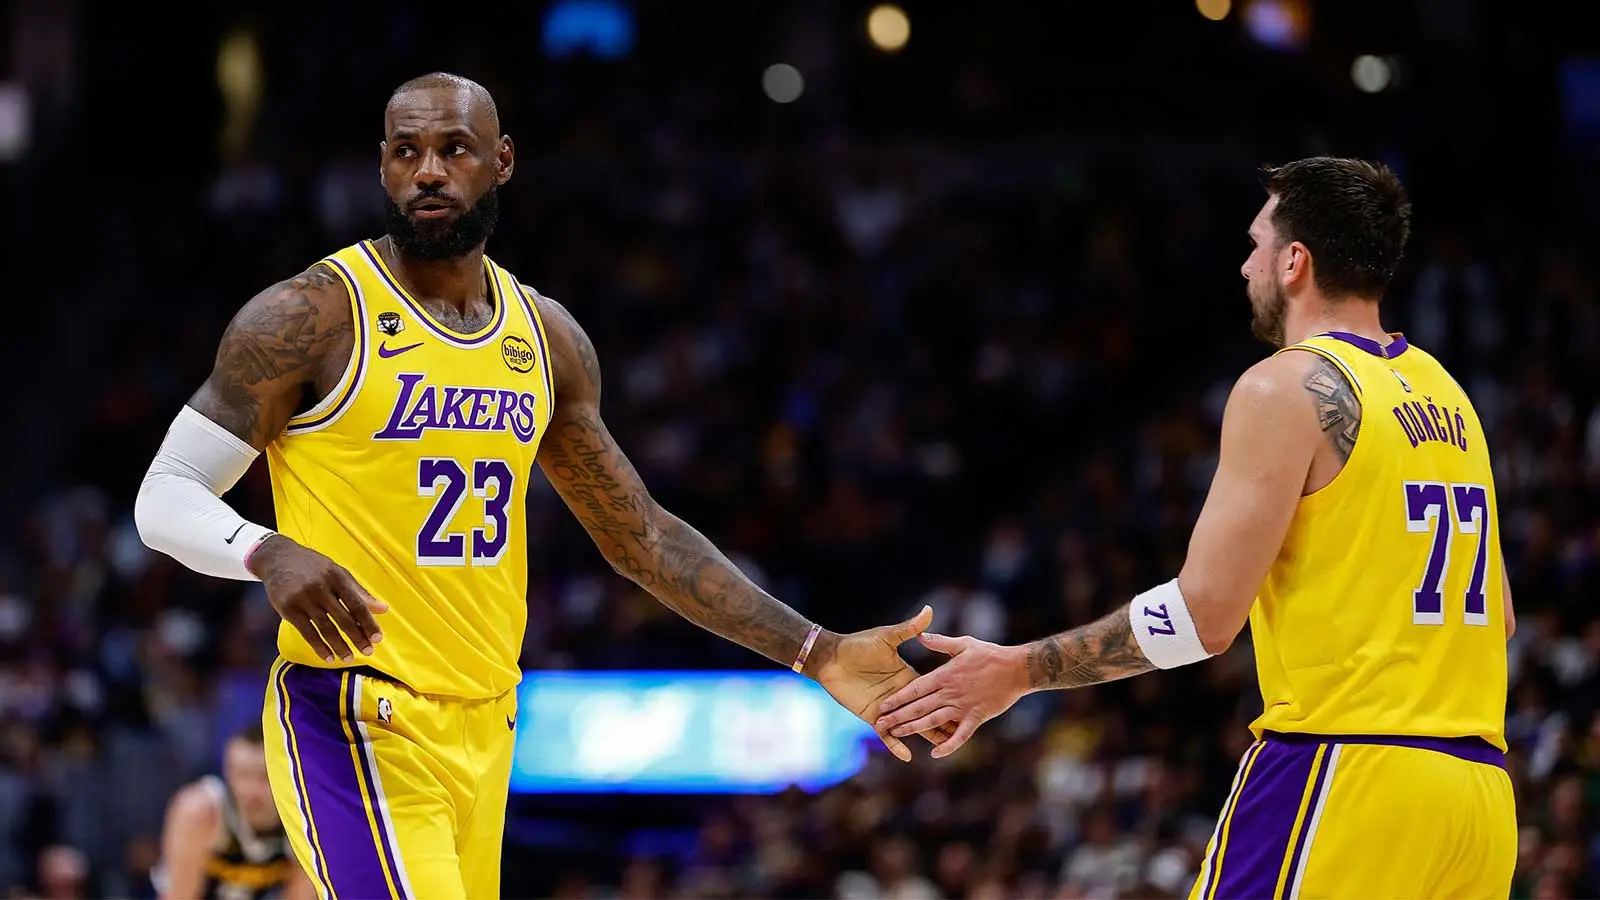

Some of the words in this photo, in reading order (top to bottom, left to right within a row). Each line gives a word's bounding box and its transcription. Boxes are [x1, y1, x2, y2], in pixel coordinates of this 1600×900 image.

[504, 344, 533, 363] bibigo
[371, 372, 537, 445] LAKERS
[1393, 396, 1467, 452] DONČIĆ
[416, 457, 516, 566] 23
[1402, 480, 1490, 626] 77
[1143, 603, 1176, 636] 77
